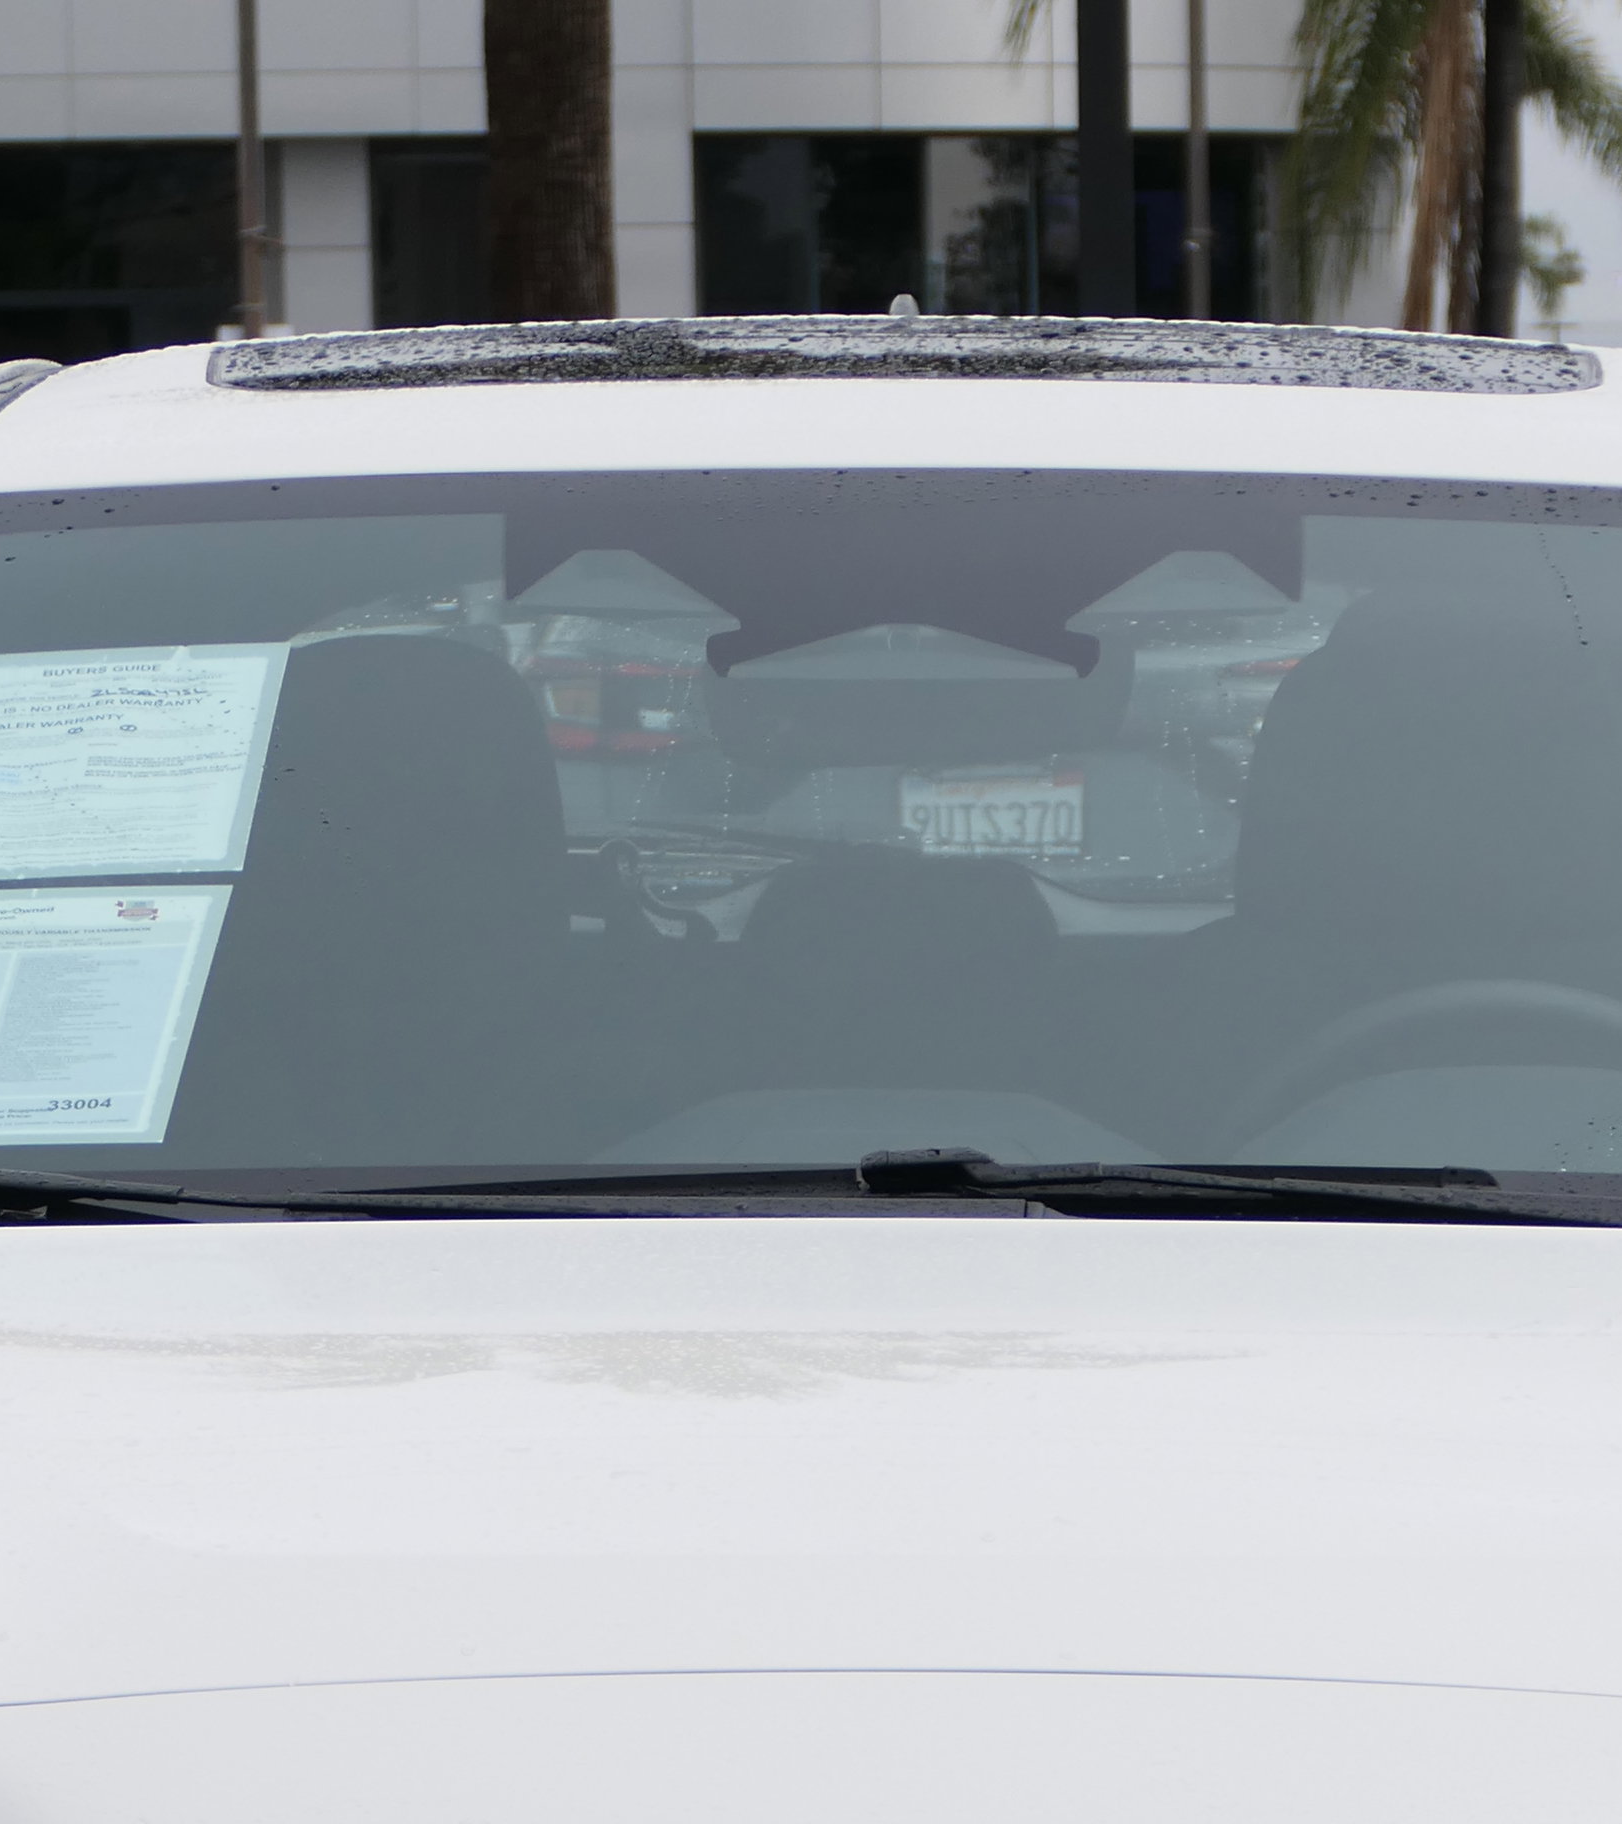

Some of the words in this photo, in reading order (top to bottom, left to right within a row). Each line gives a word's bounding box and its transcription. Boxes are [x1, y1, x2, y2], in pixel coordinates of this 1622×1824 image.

[42, 665, 107, 677] BUYERS
[113, 663, 161, 672] GUIDE
[30, 705, 52, 713] NO
[56, 698, 115, 711] DEALER
[119, 697, 204, 707] WARRANTY
[40, 713, 125, 728] WARRANTY
[48, 1098, 112, 1110] 33004
